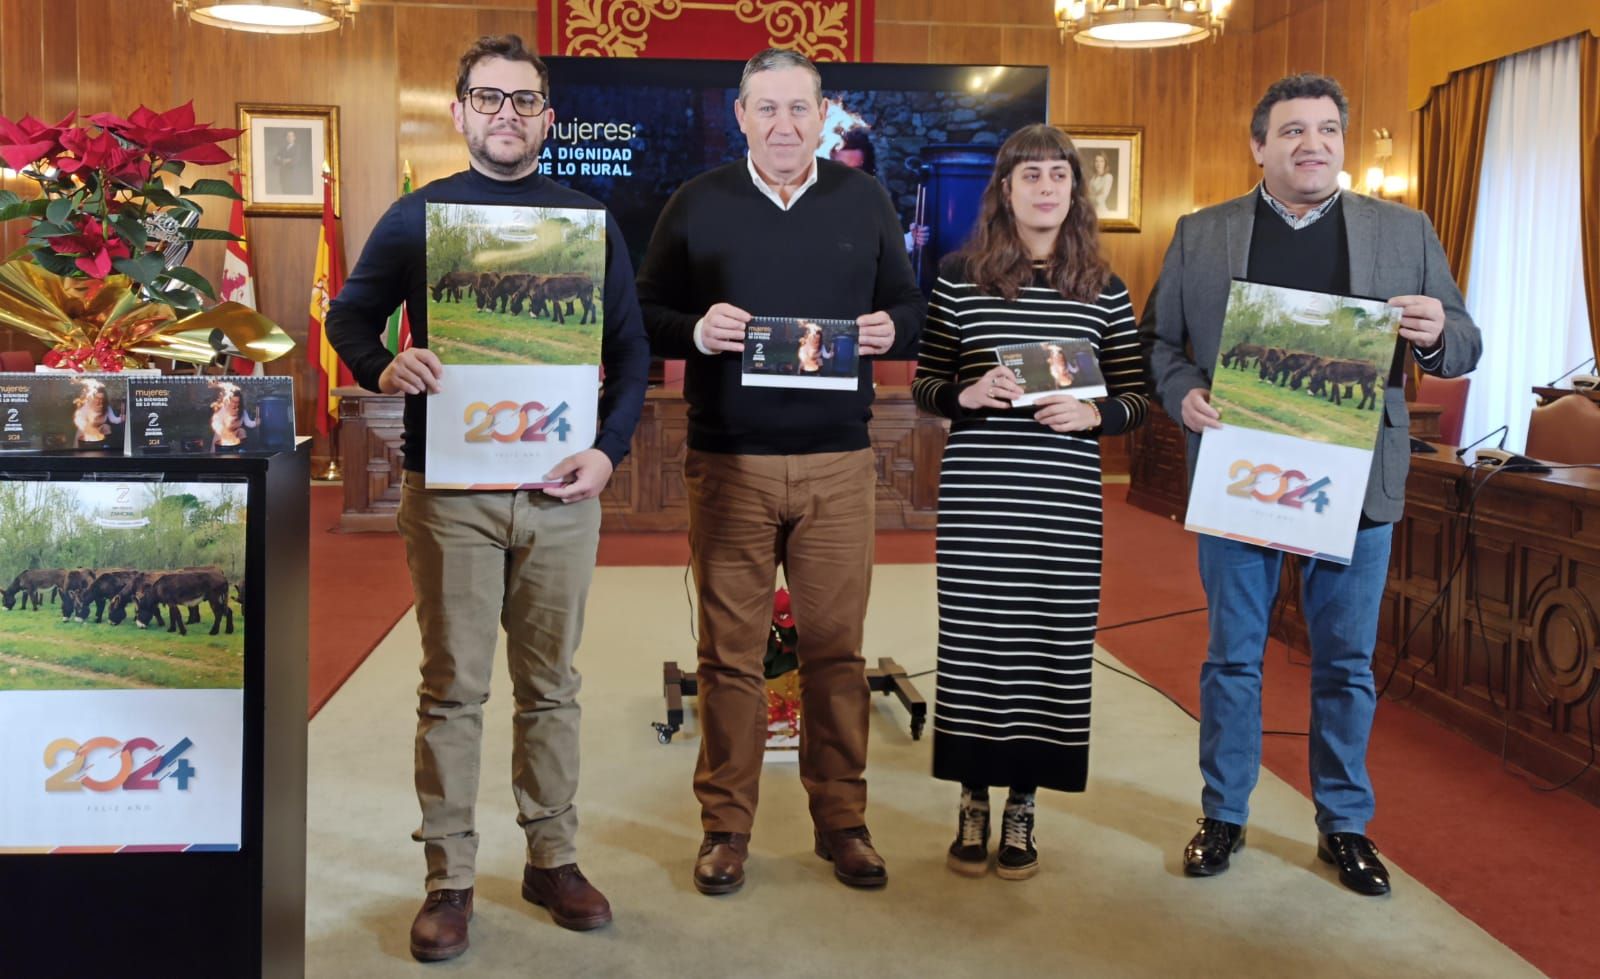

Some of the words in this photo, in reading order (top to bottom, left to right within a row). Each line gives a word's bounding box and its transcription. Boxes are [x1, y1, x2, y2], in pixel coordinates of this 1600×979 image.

[538, 147, 552, 160] A
[558, 147, 632, 161] DIGNIDAD
[557, 162, 576, 176] LO
[581, 163, 632, 177] RURAL
[464, 400, 571, 443] 2024
[1226, 459, 1332, 513] 2024
[43, 736, 195, 792] 2024
